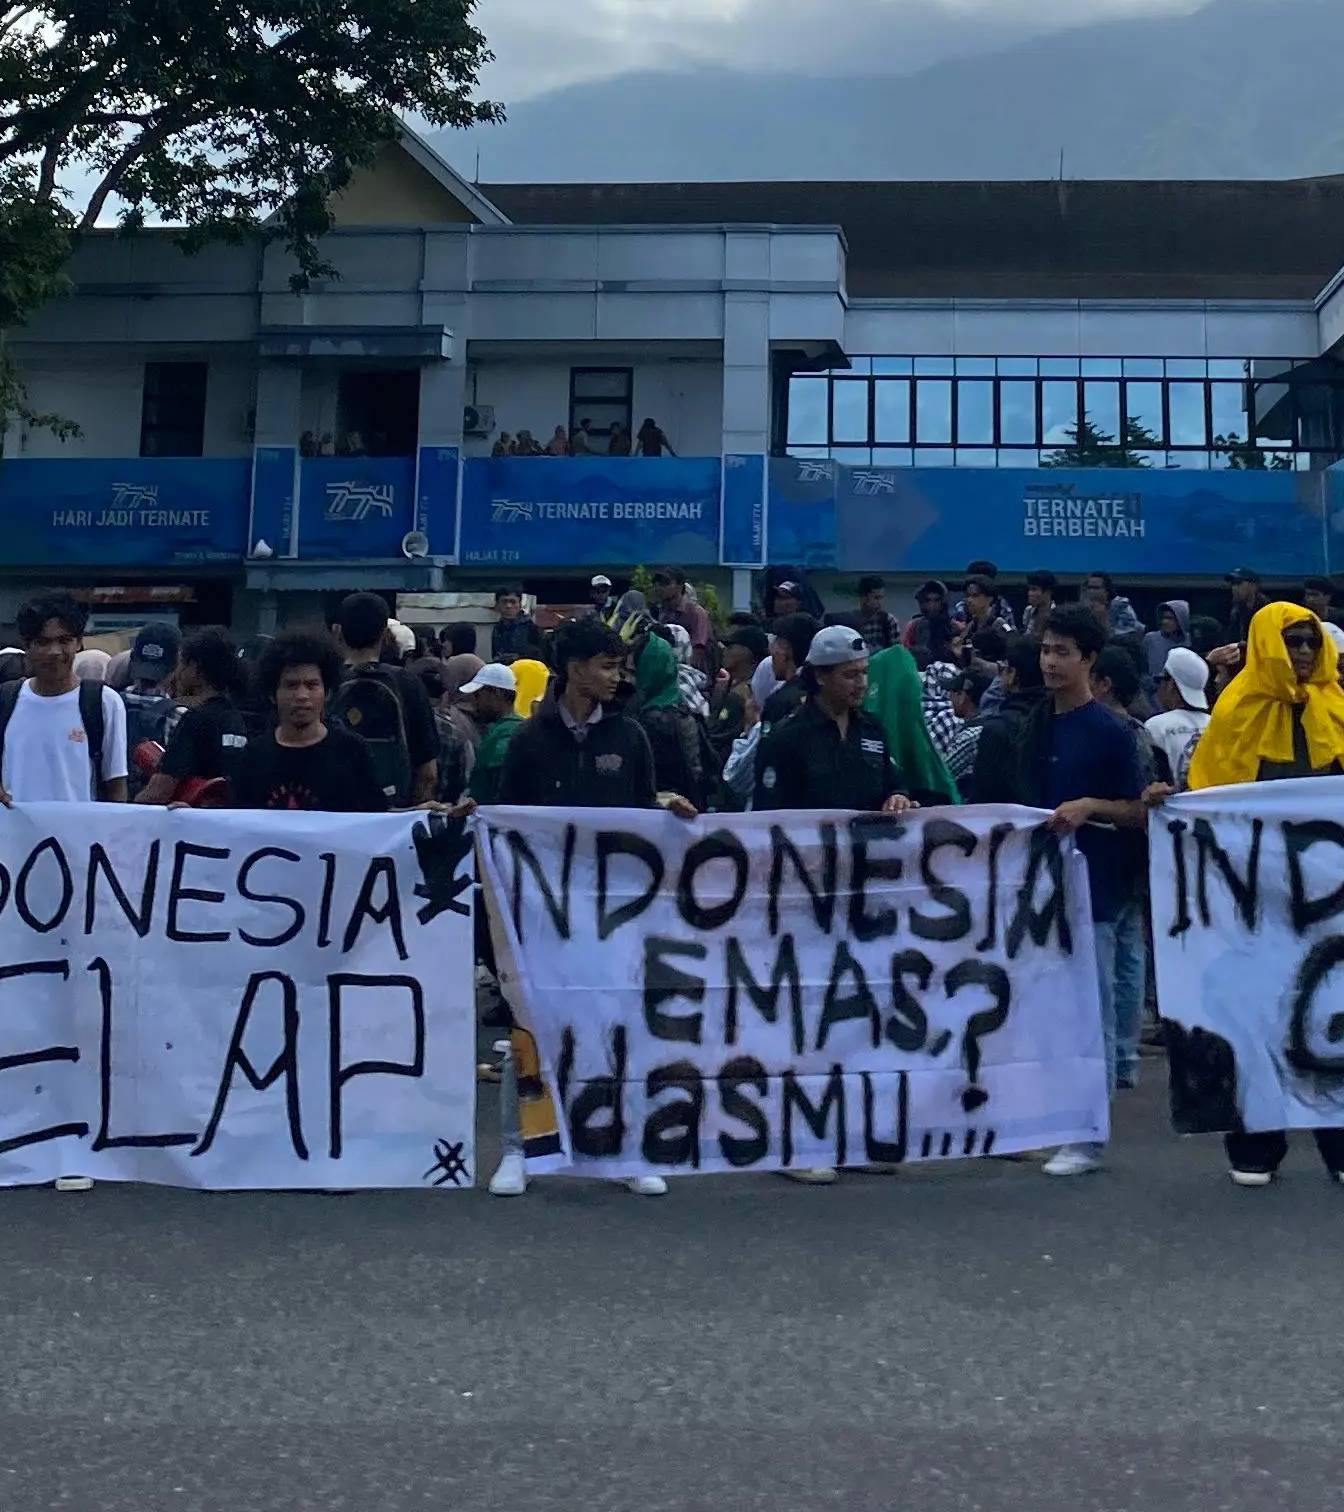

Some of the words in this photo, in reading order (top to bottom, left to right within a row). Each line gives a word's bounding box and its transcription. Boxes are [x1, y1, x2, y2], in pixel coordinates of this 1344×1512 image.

[536, 502, 609, 519] TERNATE
[611, 502, 703, 520] BERBENAH
[1022, 499, 1125, 518] TERNATE
[52, 509, 92, 527] HARI
[95, 509, 134, 527] JADI
[135, 509, 211, 527] TERNATE
[1023, 518, 1146, 538] BERBENAH
